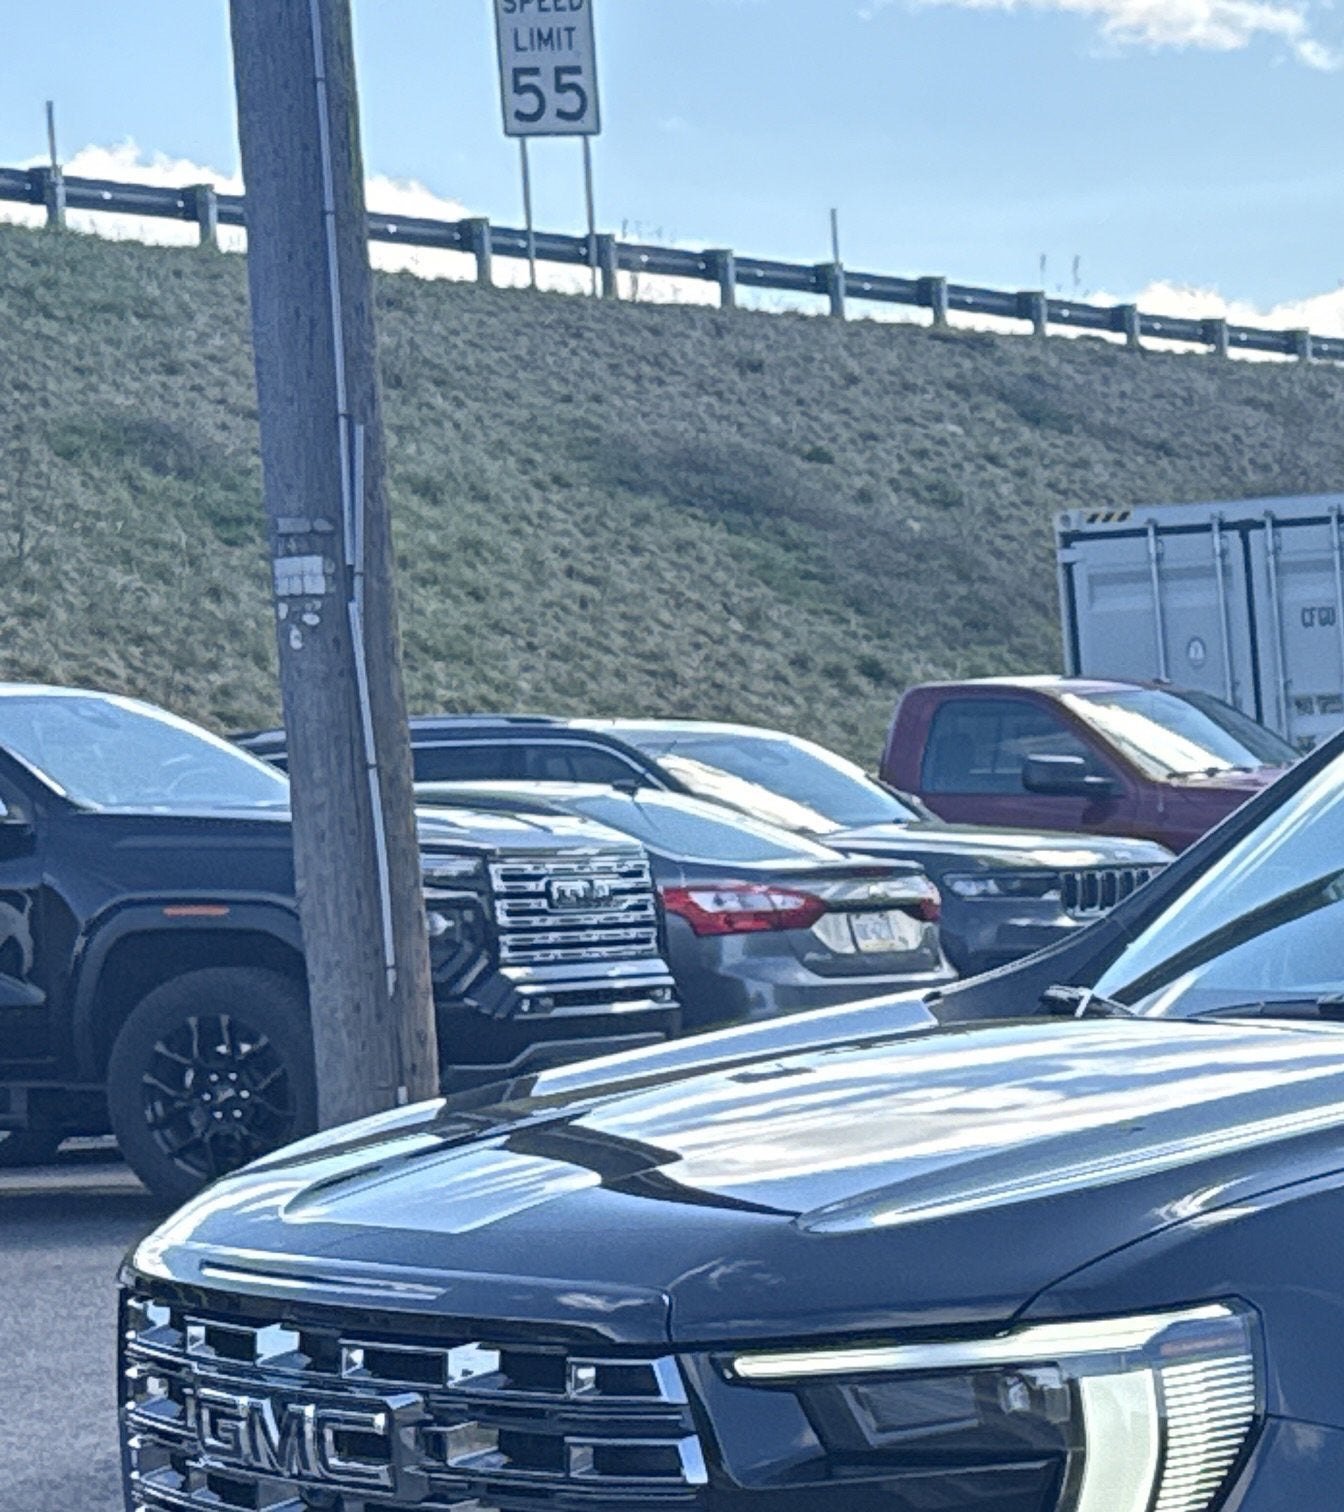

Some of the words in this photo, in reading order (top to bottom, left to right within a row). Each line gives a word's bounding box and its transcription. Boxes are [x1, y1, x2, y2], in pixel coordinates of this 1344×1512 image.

[513, 27, 577, 52] LIMIT
[512, 65, 588, 123] 55
[199, 1394, 396, 1490] GMC
